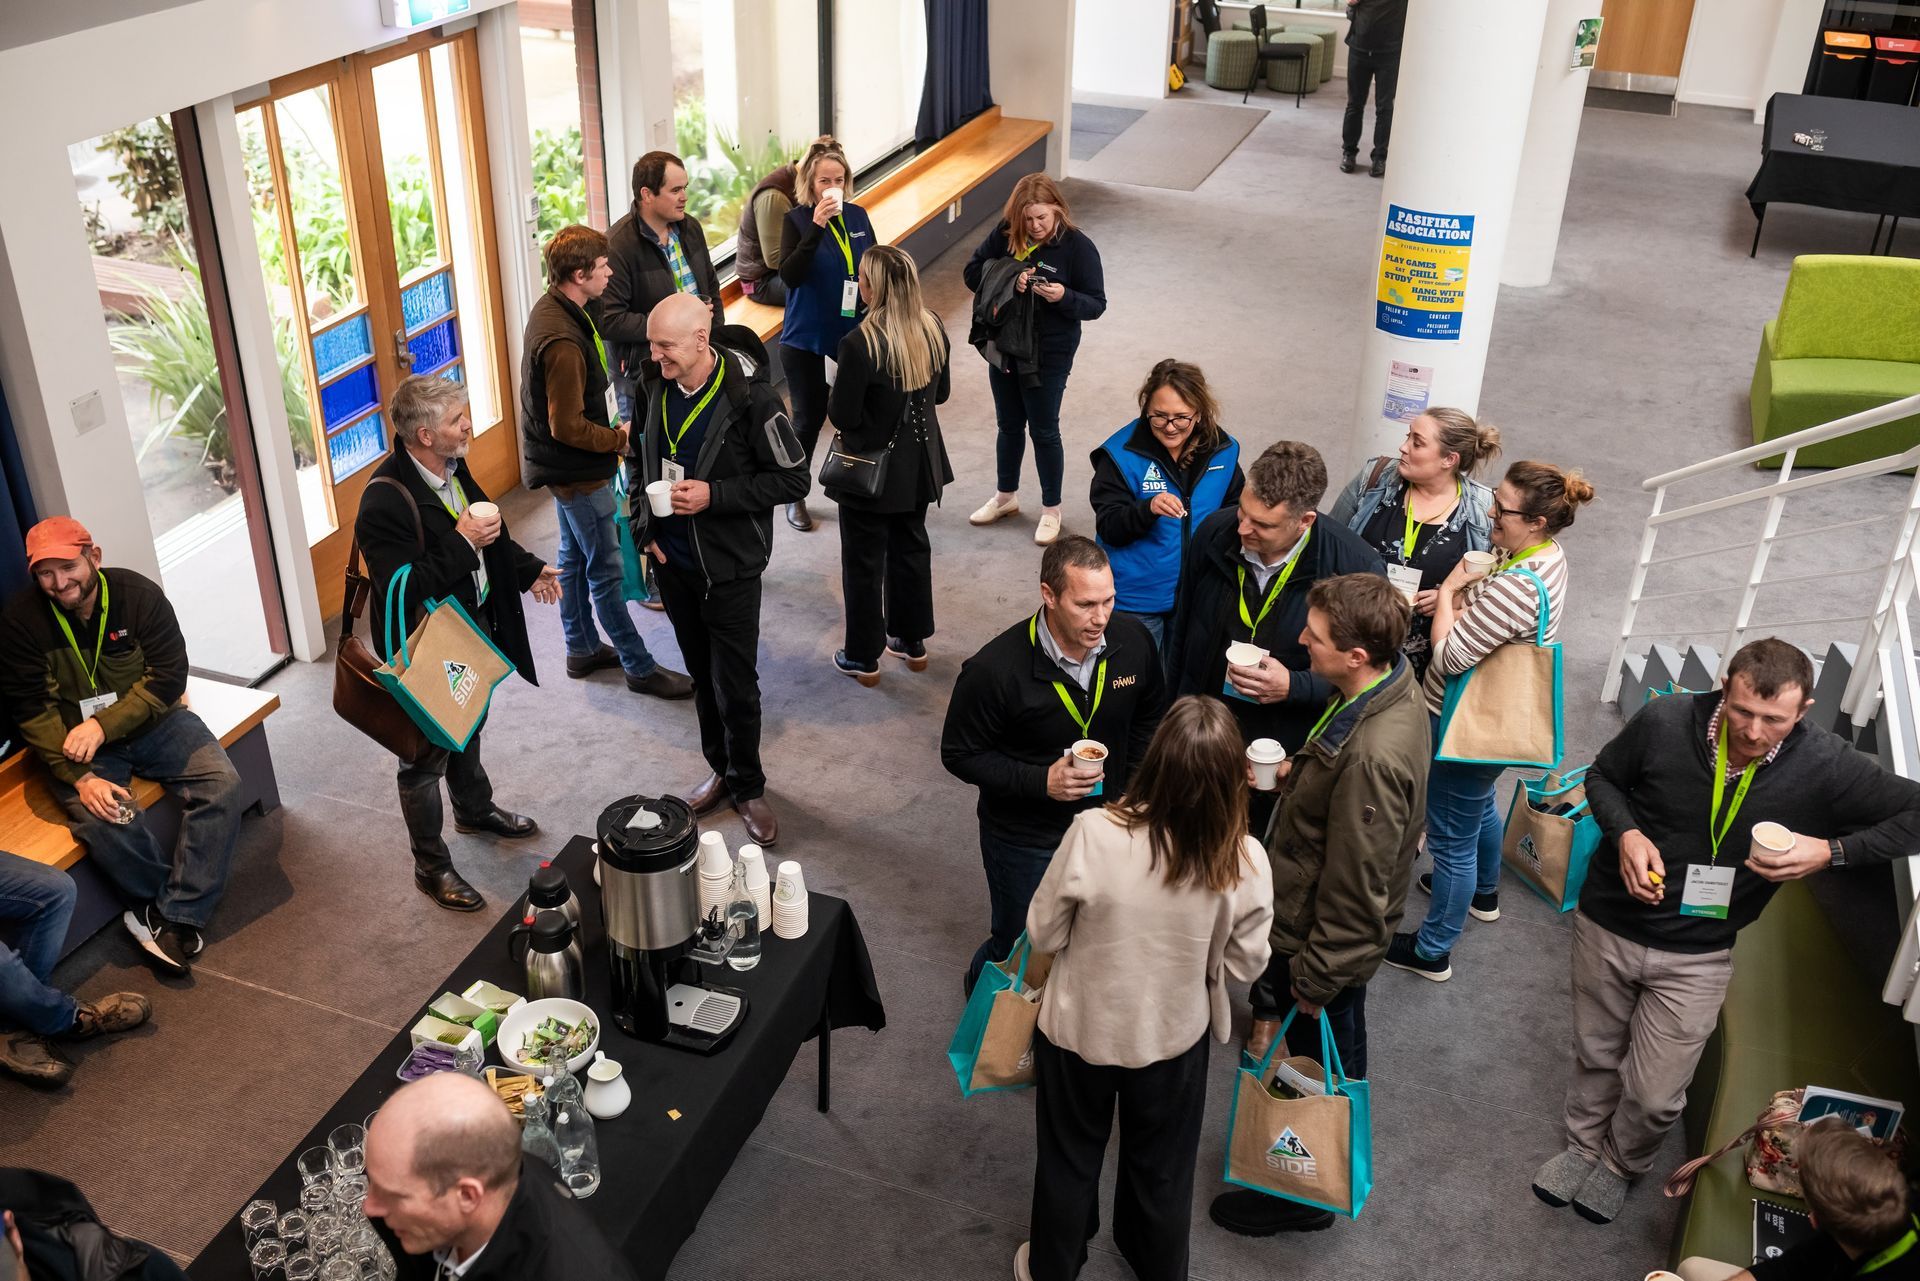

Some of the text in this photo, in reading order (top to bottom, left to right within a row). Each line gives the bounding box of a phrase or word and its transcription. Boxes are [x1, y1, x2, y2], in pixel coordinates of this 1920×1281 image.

[1397, 210, 1460, 229] PASIFIKA
[1388, 220, 1471, 240] ASSOCIATION
[1385, 254, 1437, 269] PLAY GAMES
[1384, 271, 1413, 283] STUDY
[1409, 269, 1438, 280] CHILL
[1411, 286, 1464, 297] HANG WITH
[1416, 295, 1455, 304] FRIENDS
[1385, 305, 1401, 315] FOLLOW
[1142, 481, 1168, 491] SIDE
[454, 665, 478, 706] SIDE
[1265, 1155, 1318, 1176] SIDE
